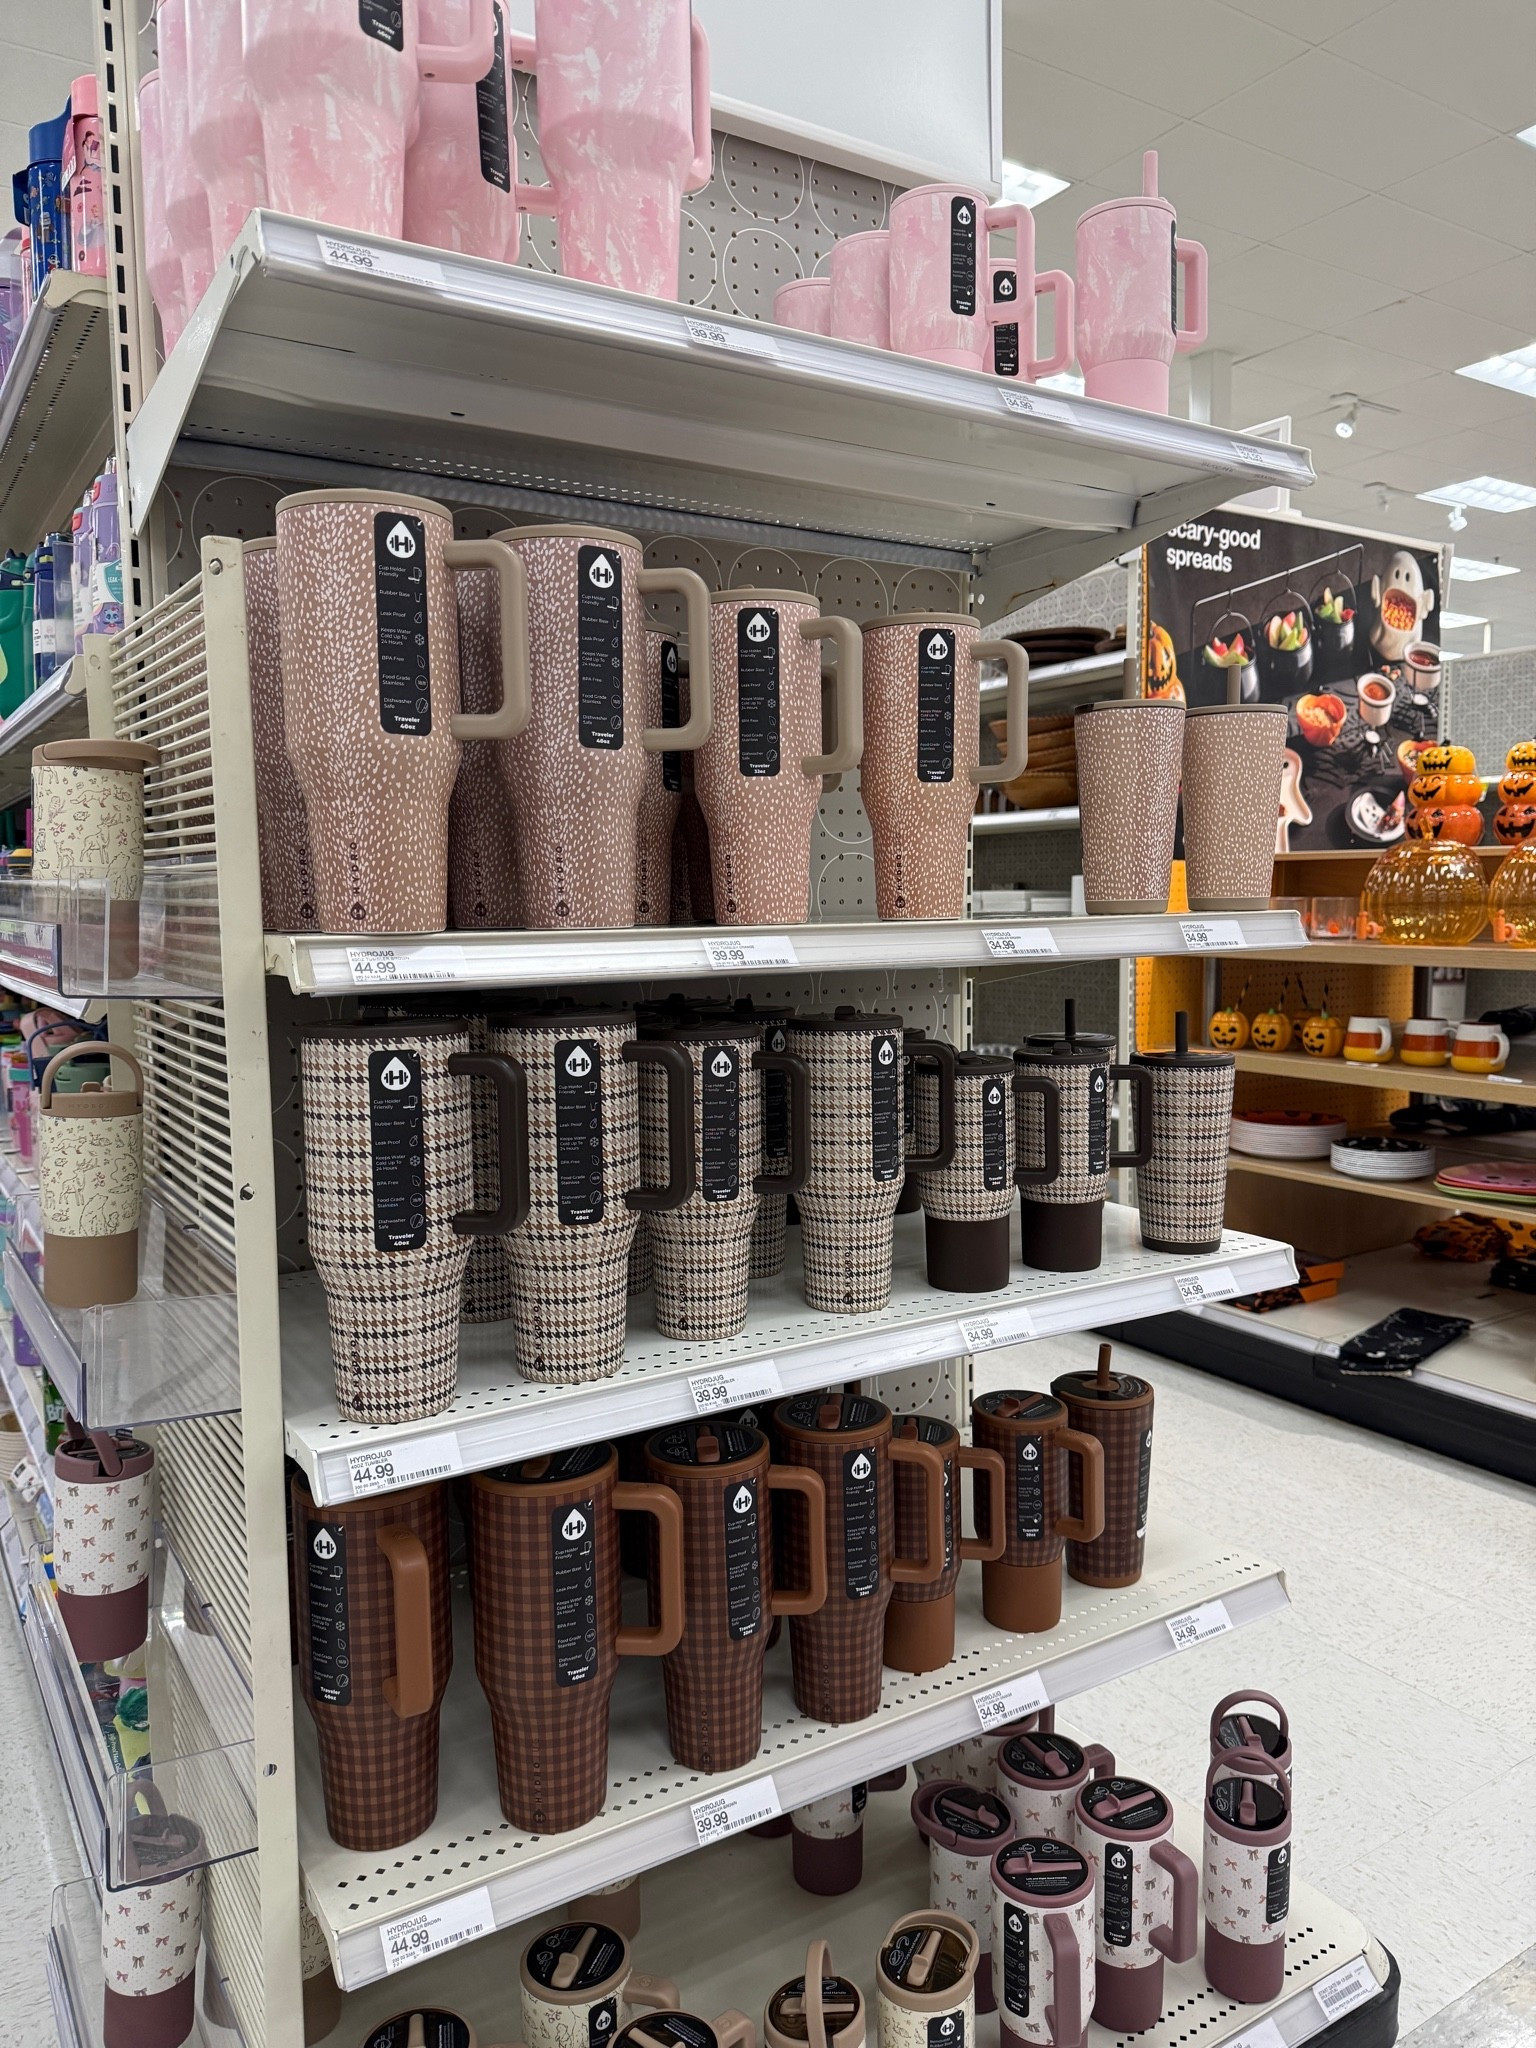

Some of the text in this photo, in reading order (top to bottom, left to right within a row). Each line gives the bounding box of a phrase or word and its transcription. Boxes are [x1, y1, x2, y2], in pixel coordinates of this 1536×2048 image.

[329, 250, 373, 268] 44.99
[691, 328, 726, 343] 39.99
[1166, 548, 1233, 573] spreads
[300, 849, 309, 896] HYDRO
[350, 842, 360, 894] HYDRO
[555, 846, 565, 894] HYDRO
[989, 940, 1016, 950] 34.99
[1185, 932, 1208, 943] 34.99
[712, 949, 745, 961] 39.99
[354, 961, 396, 974] 44.99
[1181, 1284, 1204, 1297] 34.99
[534, 1306, 542, 1350] HYDRO
[967, 1328, 994, 1343] 34.99
[350, 1340, 360, 1387] HYDRO
[691, 1374, 725, 1387] HYDROJUG
[695, 1386, 728, 1403] 39.99
[349, 1449, 393, 1465] HYDROJUG
[365, 1458, 388, 1466] TUMBLER
[353, 1463, 394, 1483] 44.99
[738, 1622, 756, 1632] Traveler
[1174, 1624, 1197, 1642] 34.99
[567, 1666, 589, 1676] Traveler
[320, 1686, 340, 1695] Traveler
[975, 1690, 1002, 1705] HYDROJUG
[980, 1701, 1006, 1720] 34.99
[533, 1762, 542, 1803] HYDRO
[692, 1798, 726, 1816] HYDROJUG
[697, 1811, 729, 1833] 39.99
[387, 1914, 428, 1936] HYDROJUG
[401, 1925, 424, 1937] TUMBLER
[423, 1917, 442, 1929] BROWN
[391, 1929, 429, 1956] 44.99
